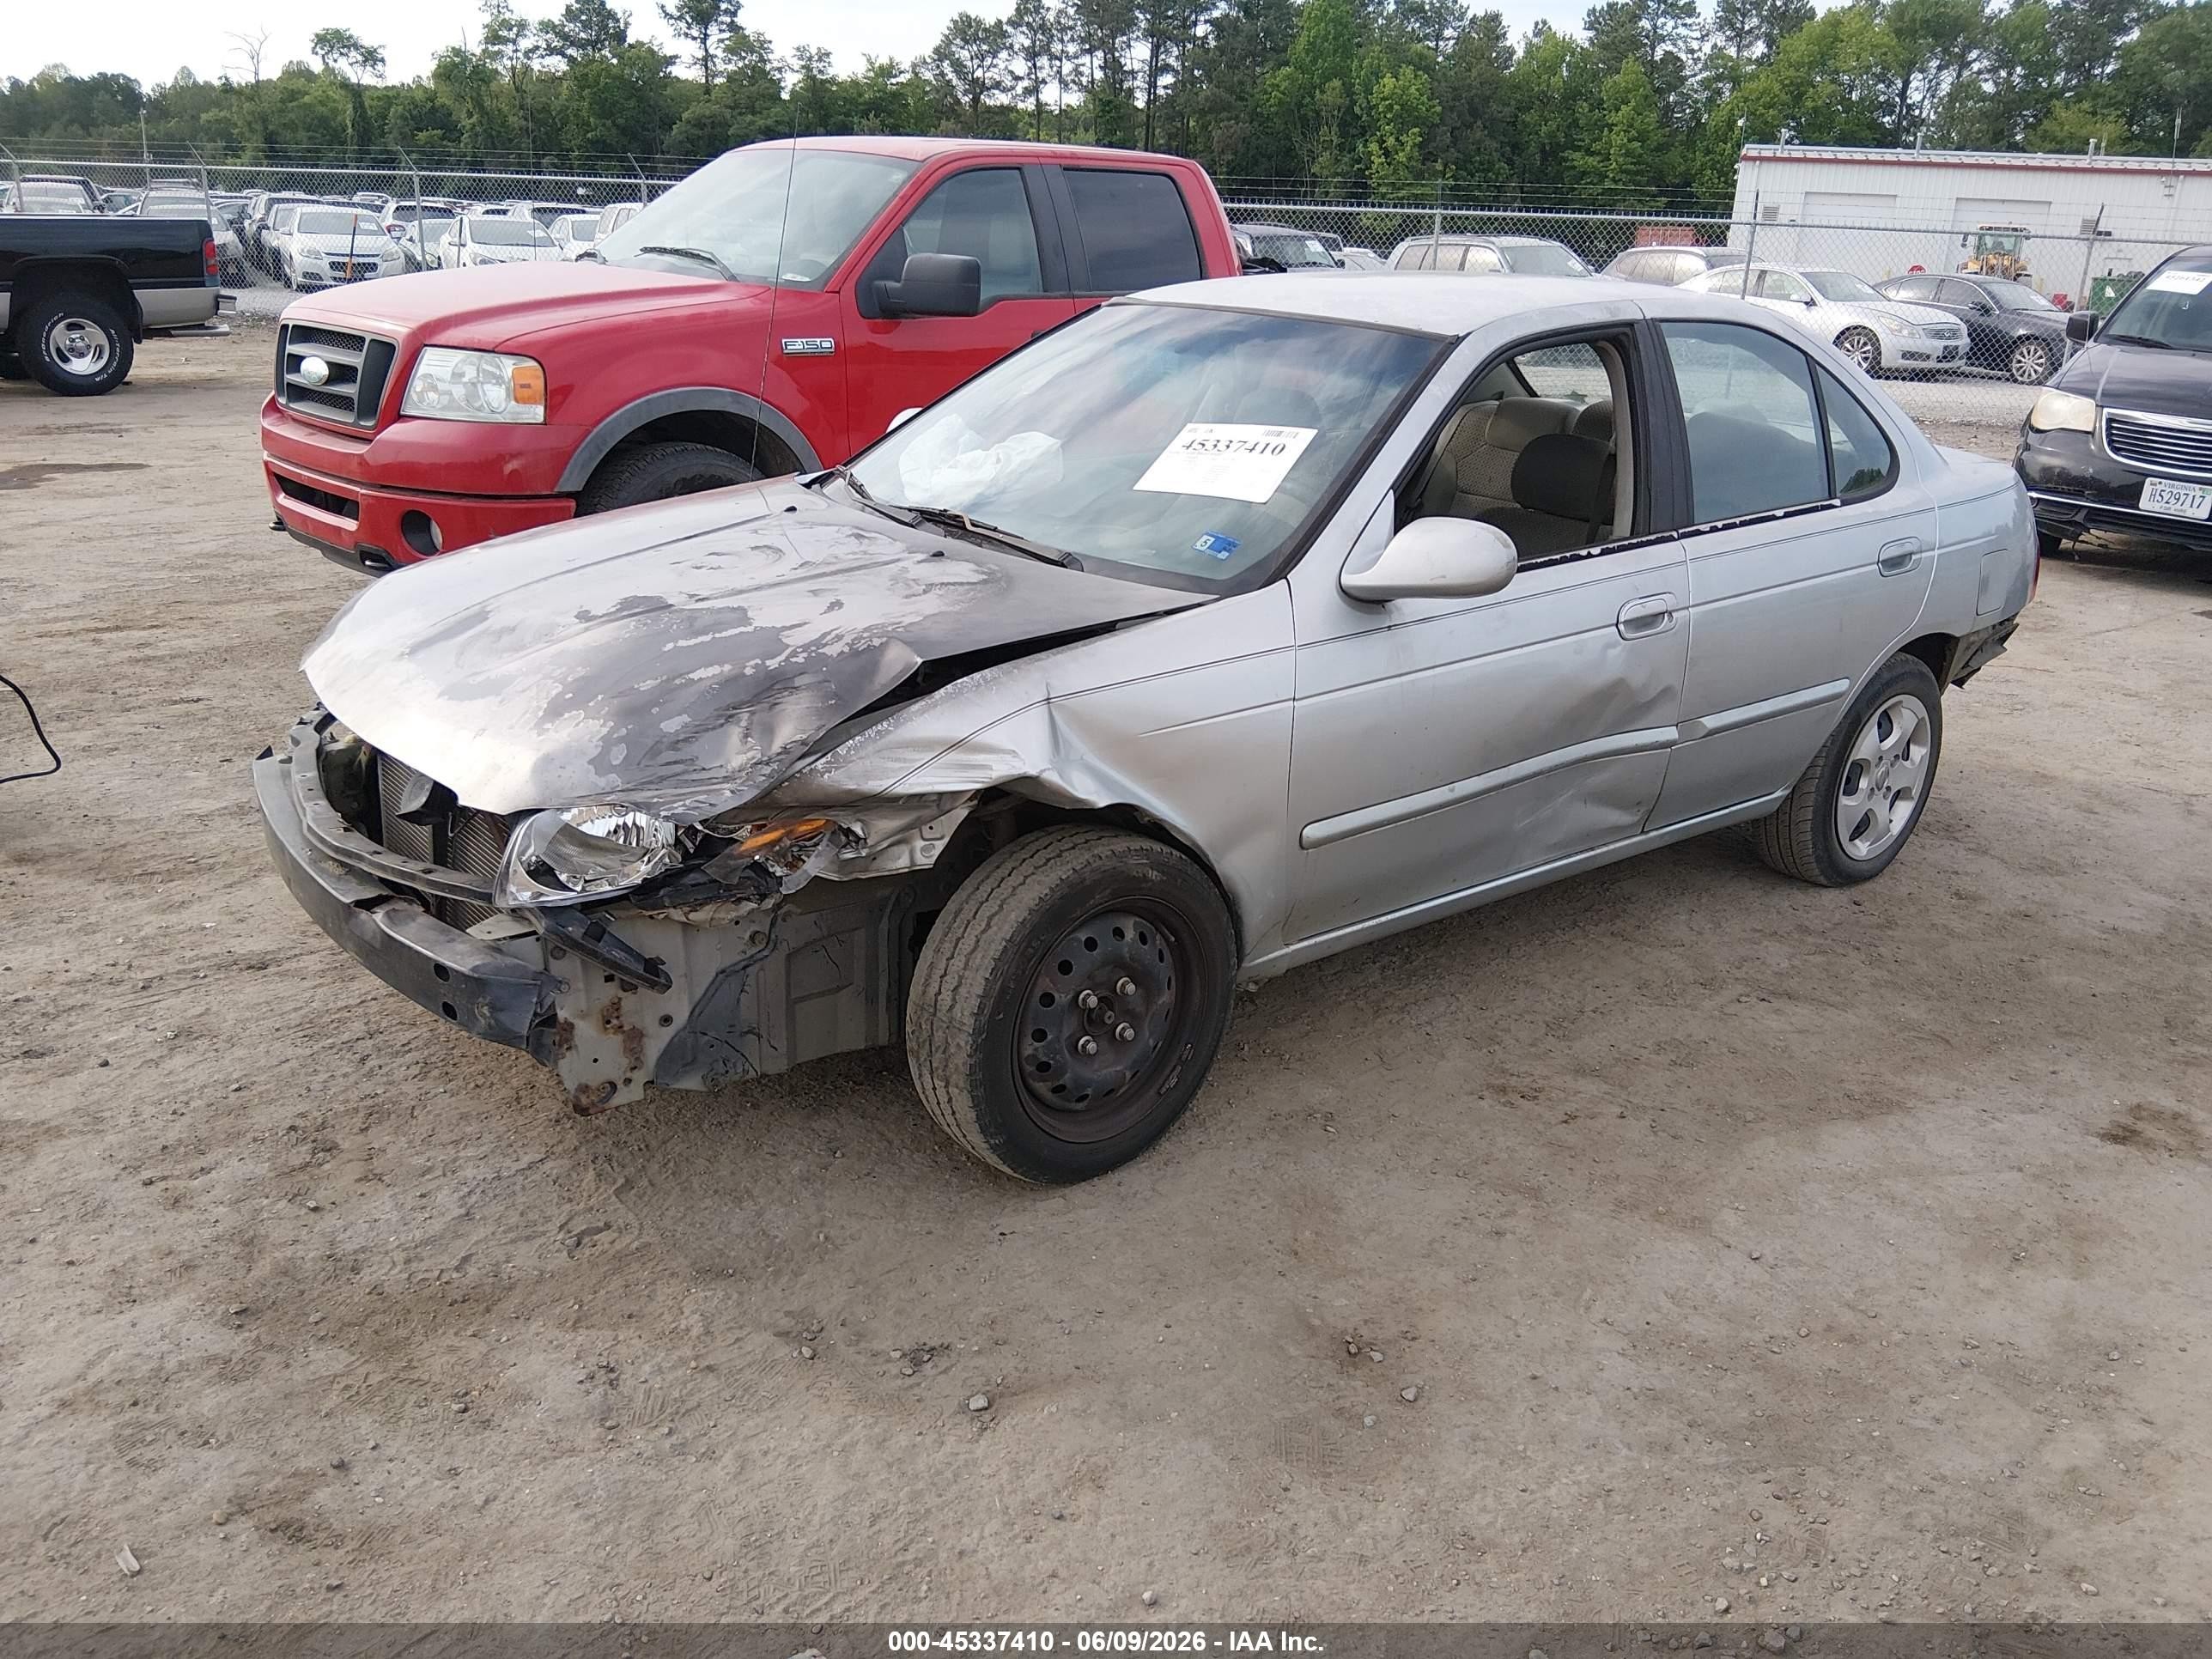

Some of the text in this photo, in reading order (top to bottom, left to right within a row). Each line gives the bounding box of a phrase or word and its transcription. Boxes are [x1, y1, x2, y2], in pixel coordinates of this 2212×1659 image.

[1182, 439, 1286, 457] 45337410
[2163, 482, 2197, 492] VIRGINIA
[2148, 488, 2207, 509] H529717
[1200, 538, 1211, 547] 5
